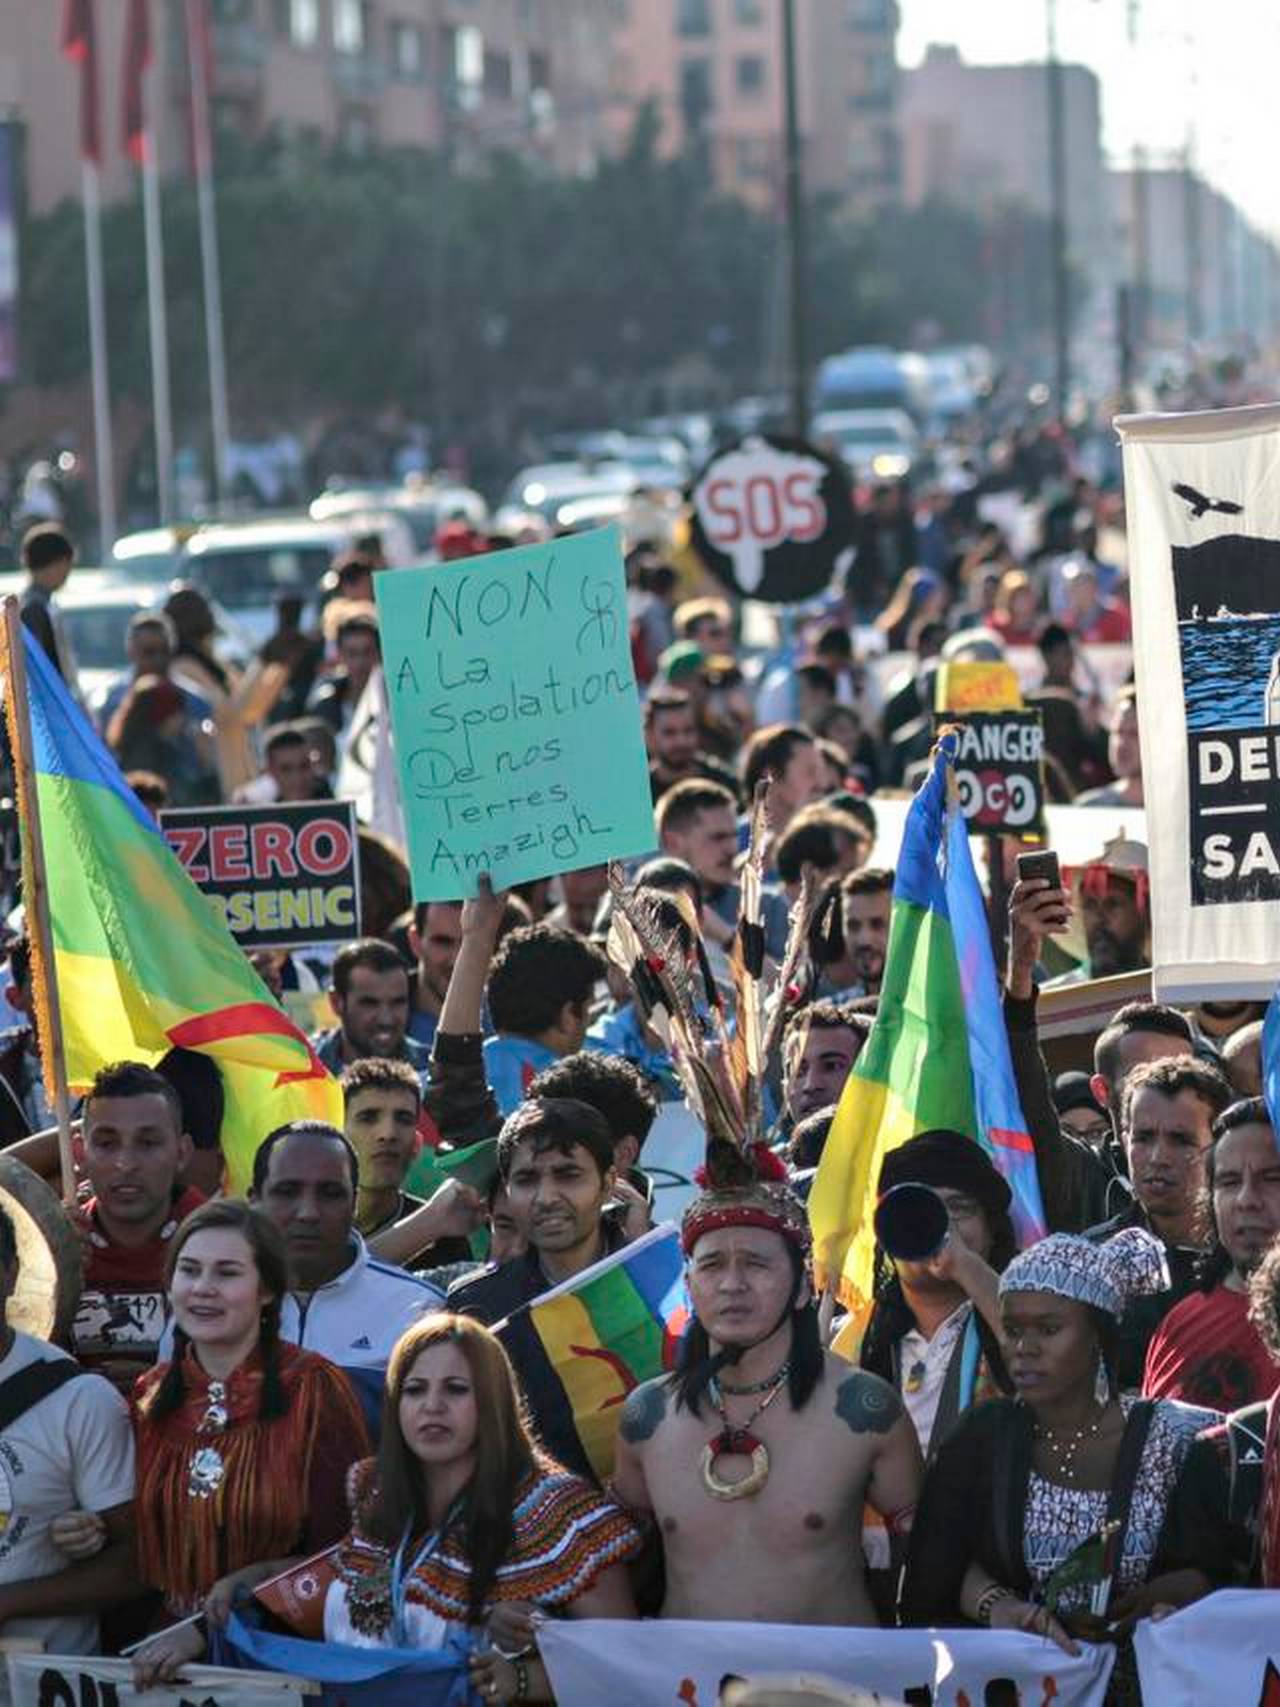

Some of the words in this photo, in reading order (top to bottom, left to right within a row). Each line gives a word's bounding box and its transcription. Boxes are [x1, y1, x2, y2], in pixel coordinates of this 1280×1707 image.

[705, 473, 826, 544] SOS
[425, 555, 556, 638] NON
[396, 656, 419, 694] A
[495, 738, 562, 773] nos
[415, 783, 569, 830] Terres
[430, 805, 613, 874] Amazigh
[164, 818, 353, 884] ZERO
